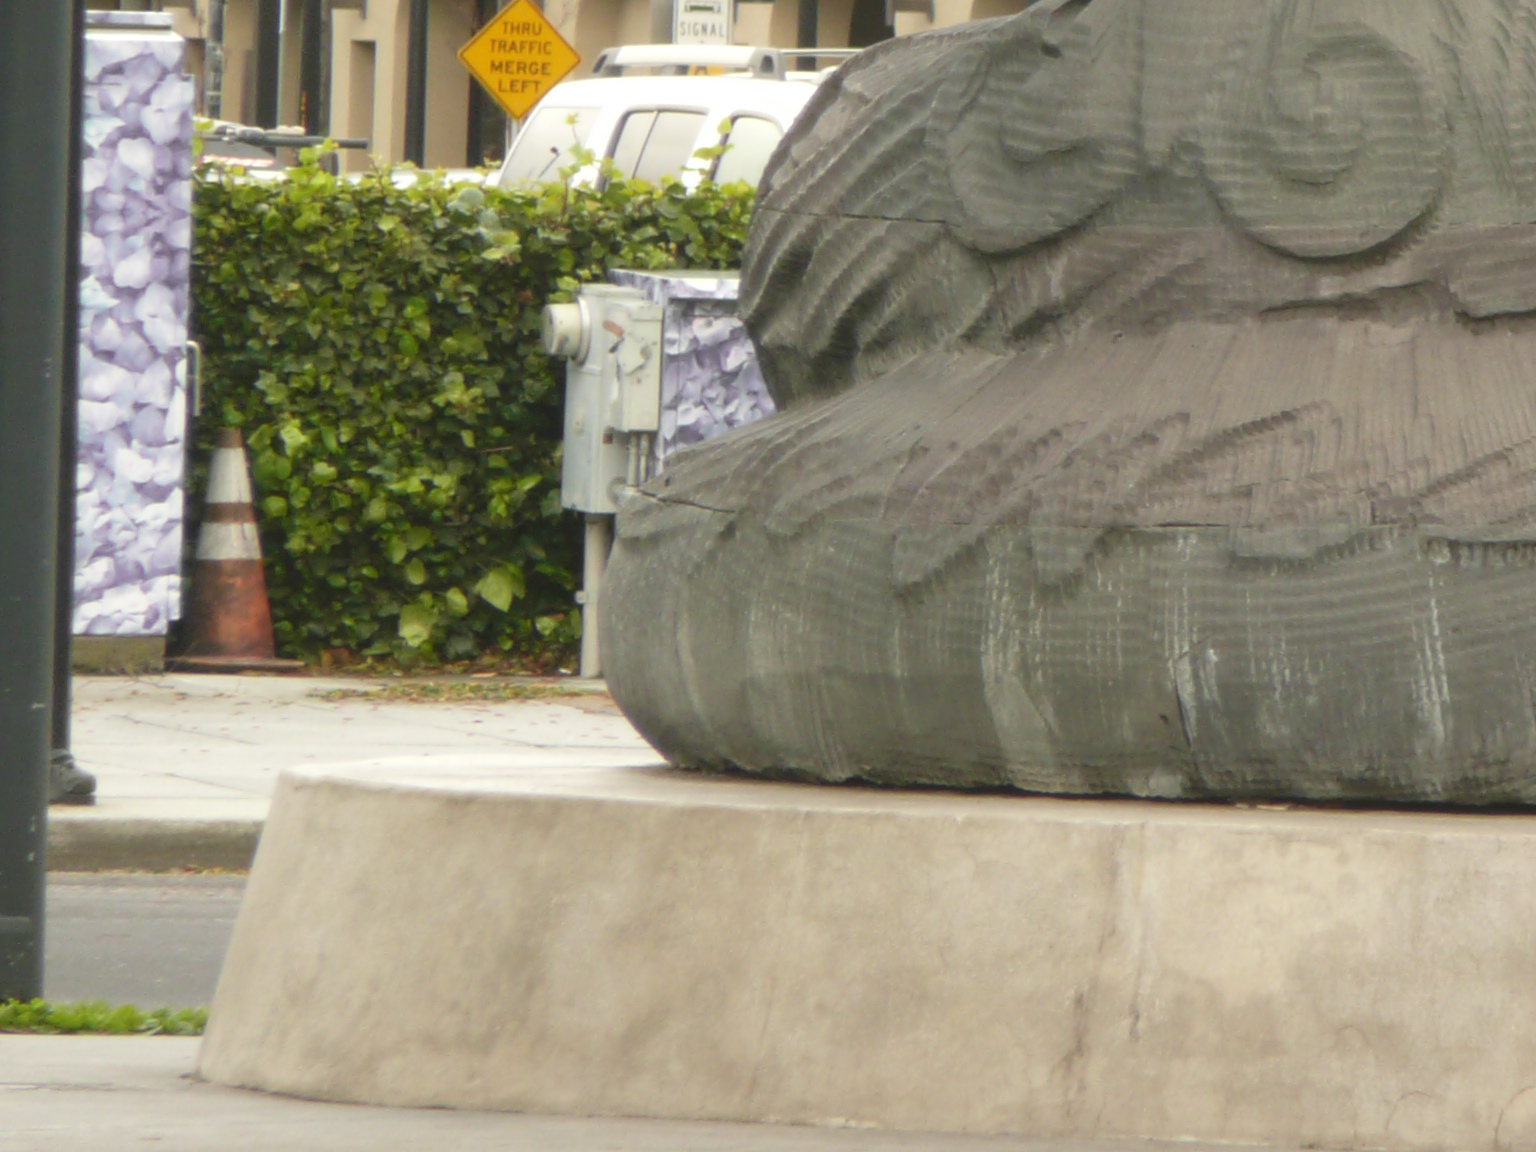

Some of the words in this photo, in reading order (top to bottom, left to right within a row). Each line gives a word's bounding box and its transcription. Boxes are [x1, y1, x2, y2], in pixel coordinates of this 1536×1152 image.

[502, 21, 543, 36] THRU
[680, 21, 725, 37] SIGNAL
[489, 38, 552, 56] TRAFFIC
[489, 60, 552, 76] MERGE
[497, 79, 542, 94] LEFT
